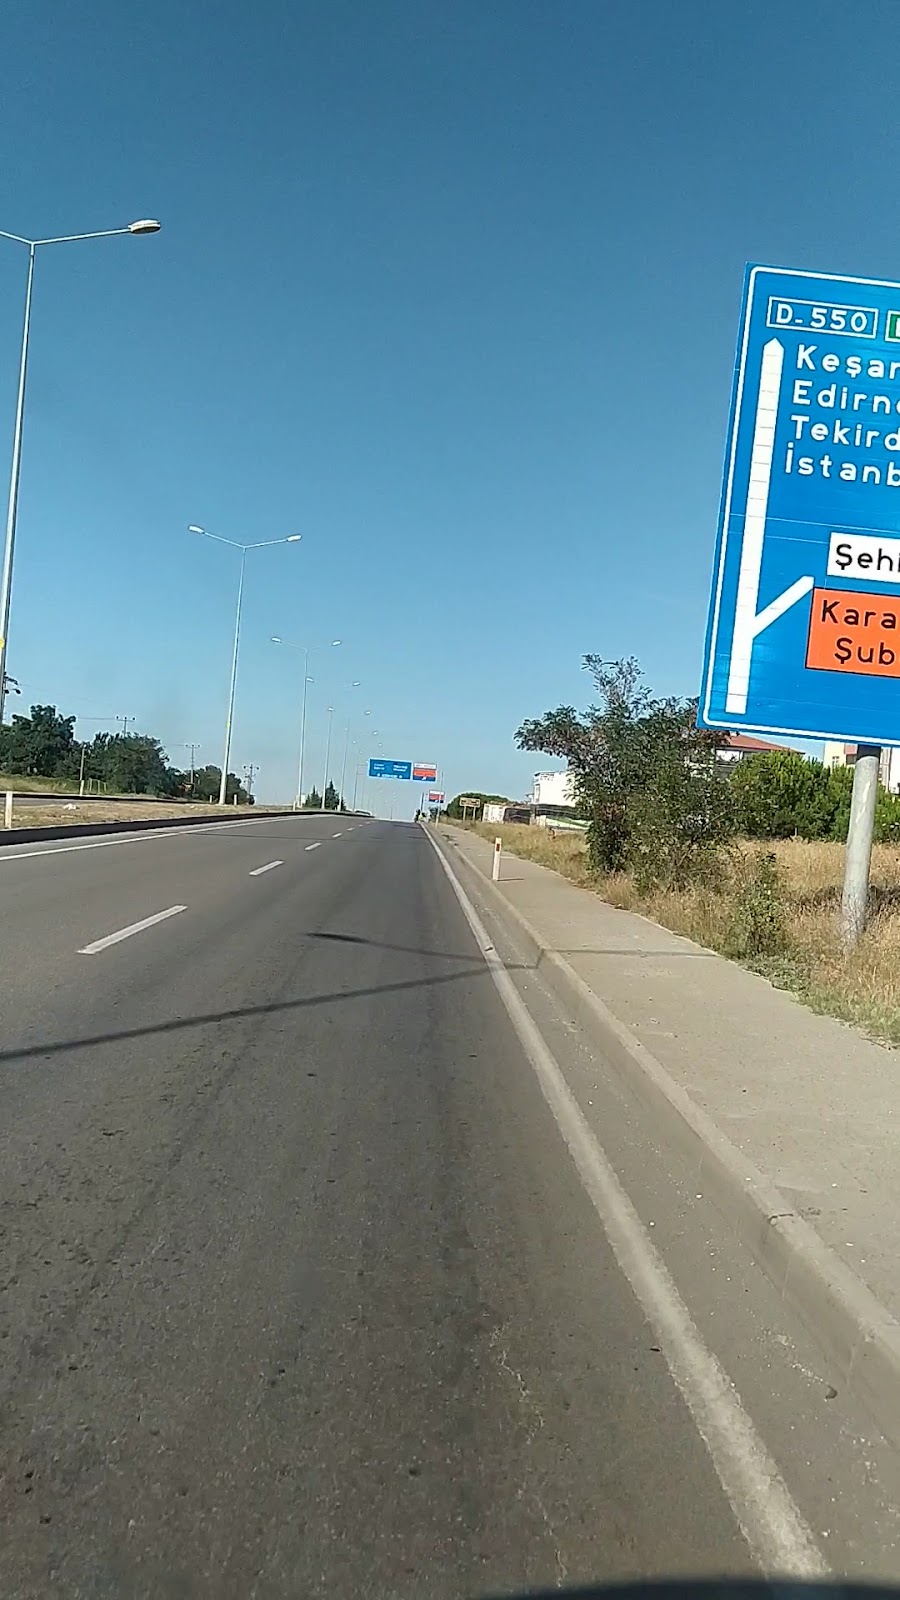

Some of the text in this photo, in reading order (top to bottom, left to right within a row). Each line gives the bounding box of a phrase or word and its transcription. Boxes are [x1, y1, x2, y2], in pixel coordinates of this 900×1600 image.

[793, 379, 900, 414] Edirn
[791, 414, 900, 451] Tekird
[821, 599, 897, 629] Kara
[834, 637, 895, 665] Şub
